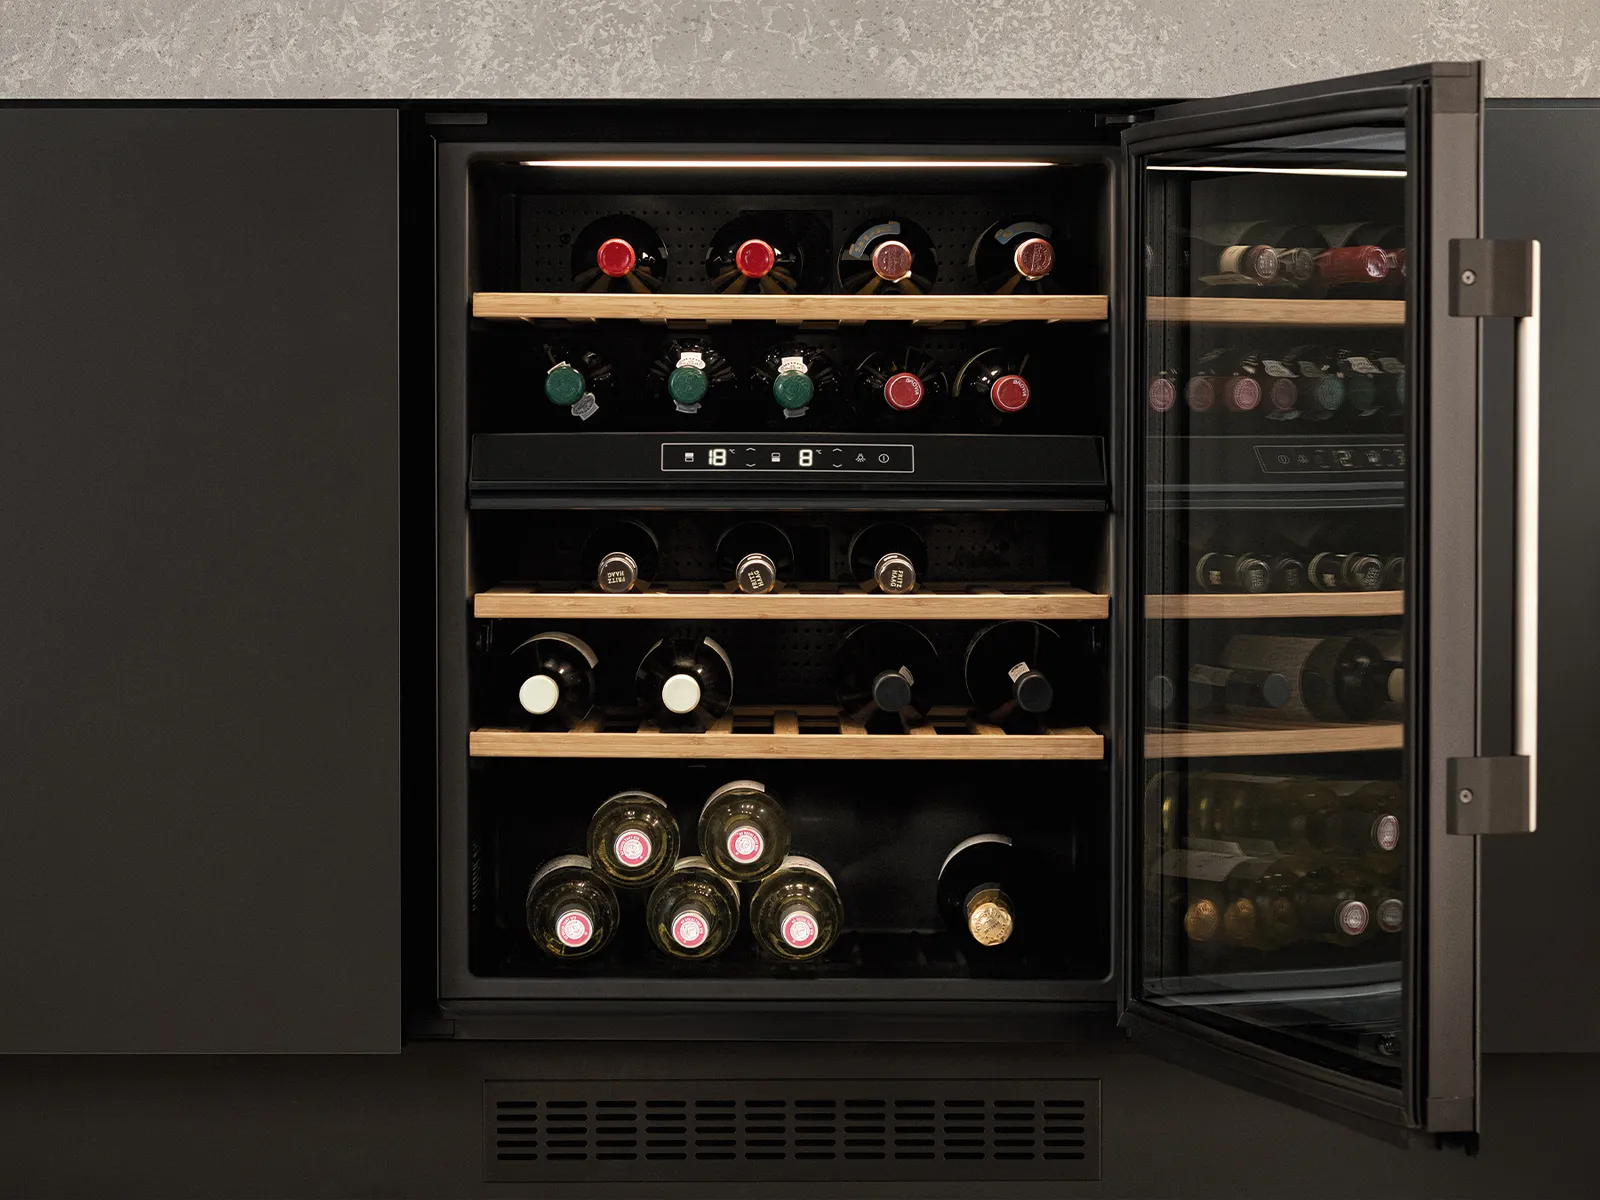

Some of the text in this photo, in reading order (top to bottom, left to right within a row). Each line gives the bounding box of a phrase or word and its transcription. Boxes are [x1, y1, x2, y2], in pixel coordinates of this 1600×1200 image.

[709, 448, 726, 466] 18
[799, 449, 813, 466] 8
[607, 570, 625, 578] HAAG
[607, 576, 625, 584] FRITZ
[747, 571, 759, 589] FRITZ
[753, 569, 764, 587] HAAG
[890, 569, 898, 587] HAAG
